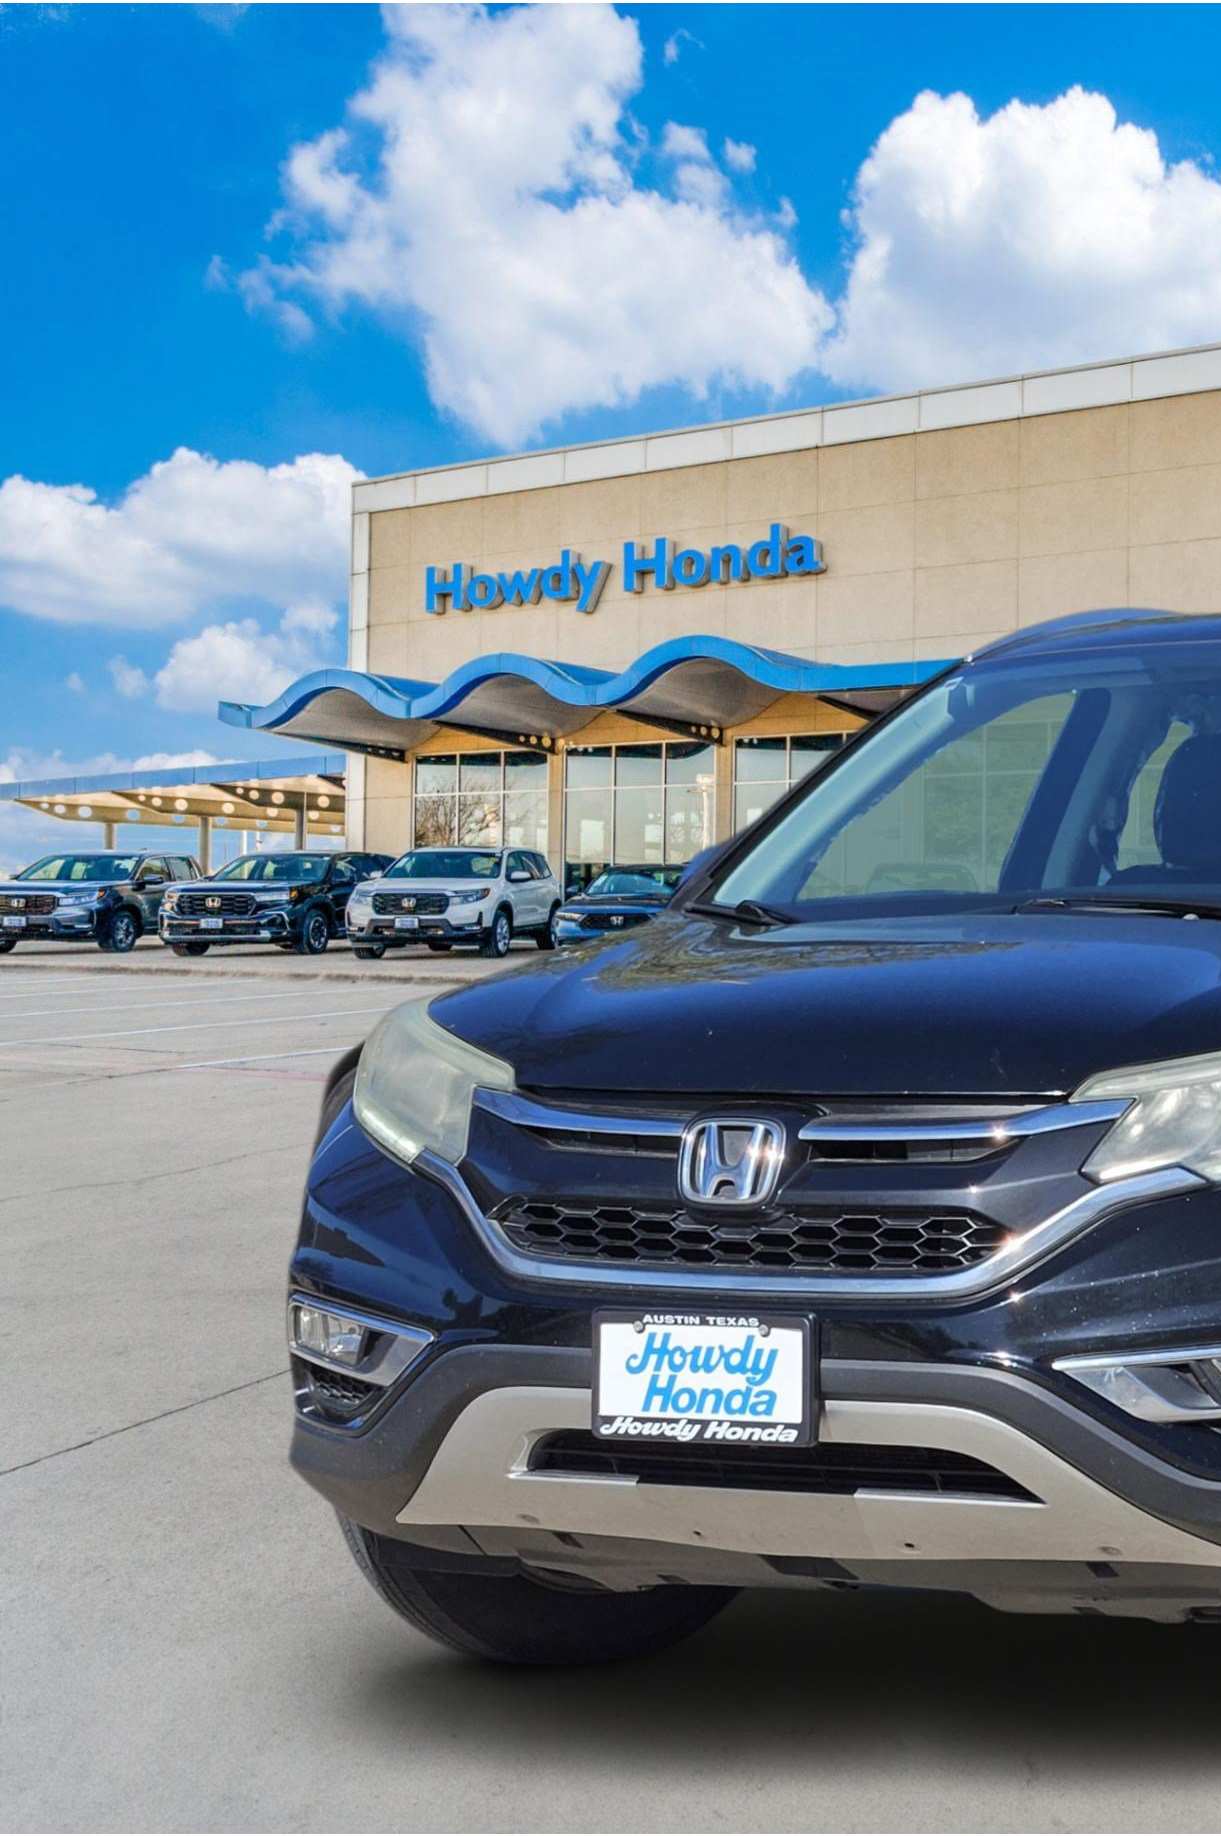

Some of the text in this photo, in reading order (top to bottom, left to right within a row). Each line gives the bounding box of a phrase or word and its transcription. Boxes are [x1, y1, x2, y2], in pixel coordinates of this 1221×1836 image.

[425, 523, 824, 613] Howdy Honda
[642, 1314, 760, 1328] AUSTIN TEXAS
[625, 1332, 779, 1387] Howdy
[641, 1374, 777, 1417] Honda
[600, 1416, 799, 1443] Howdy Honda
